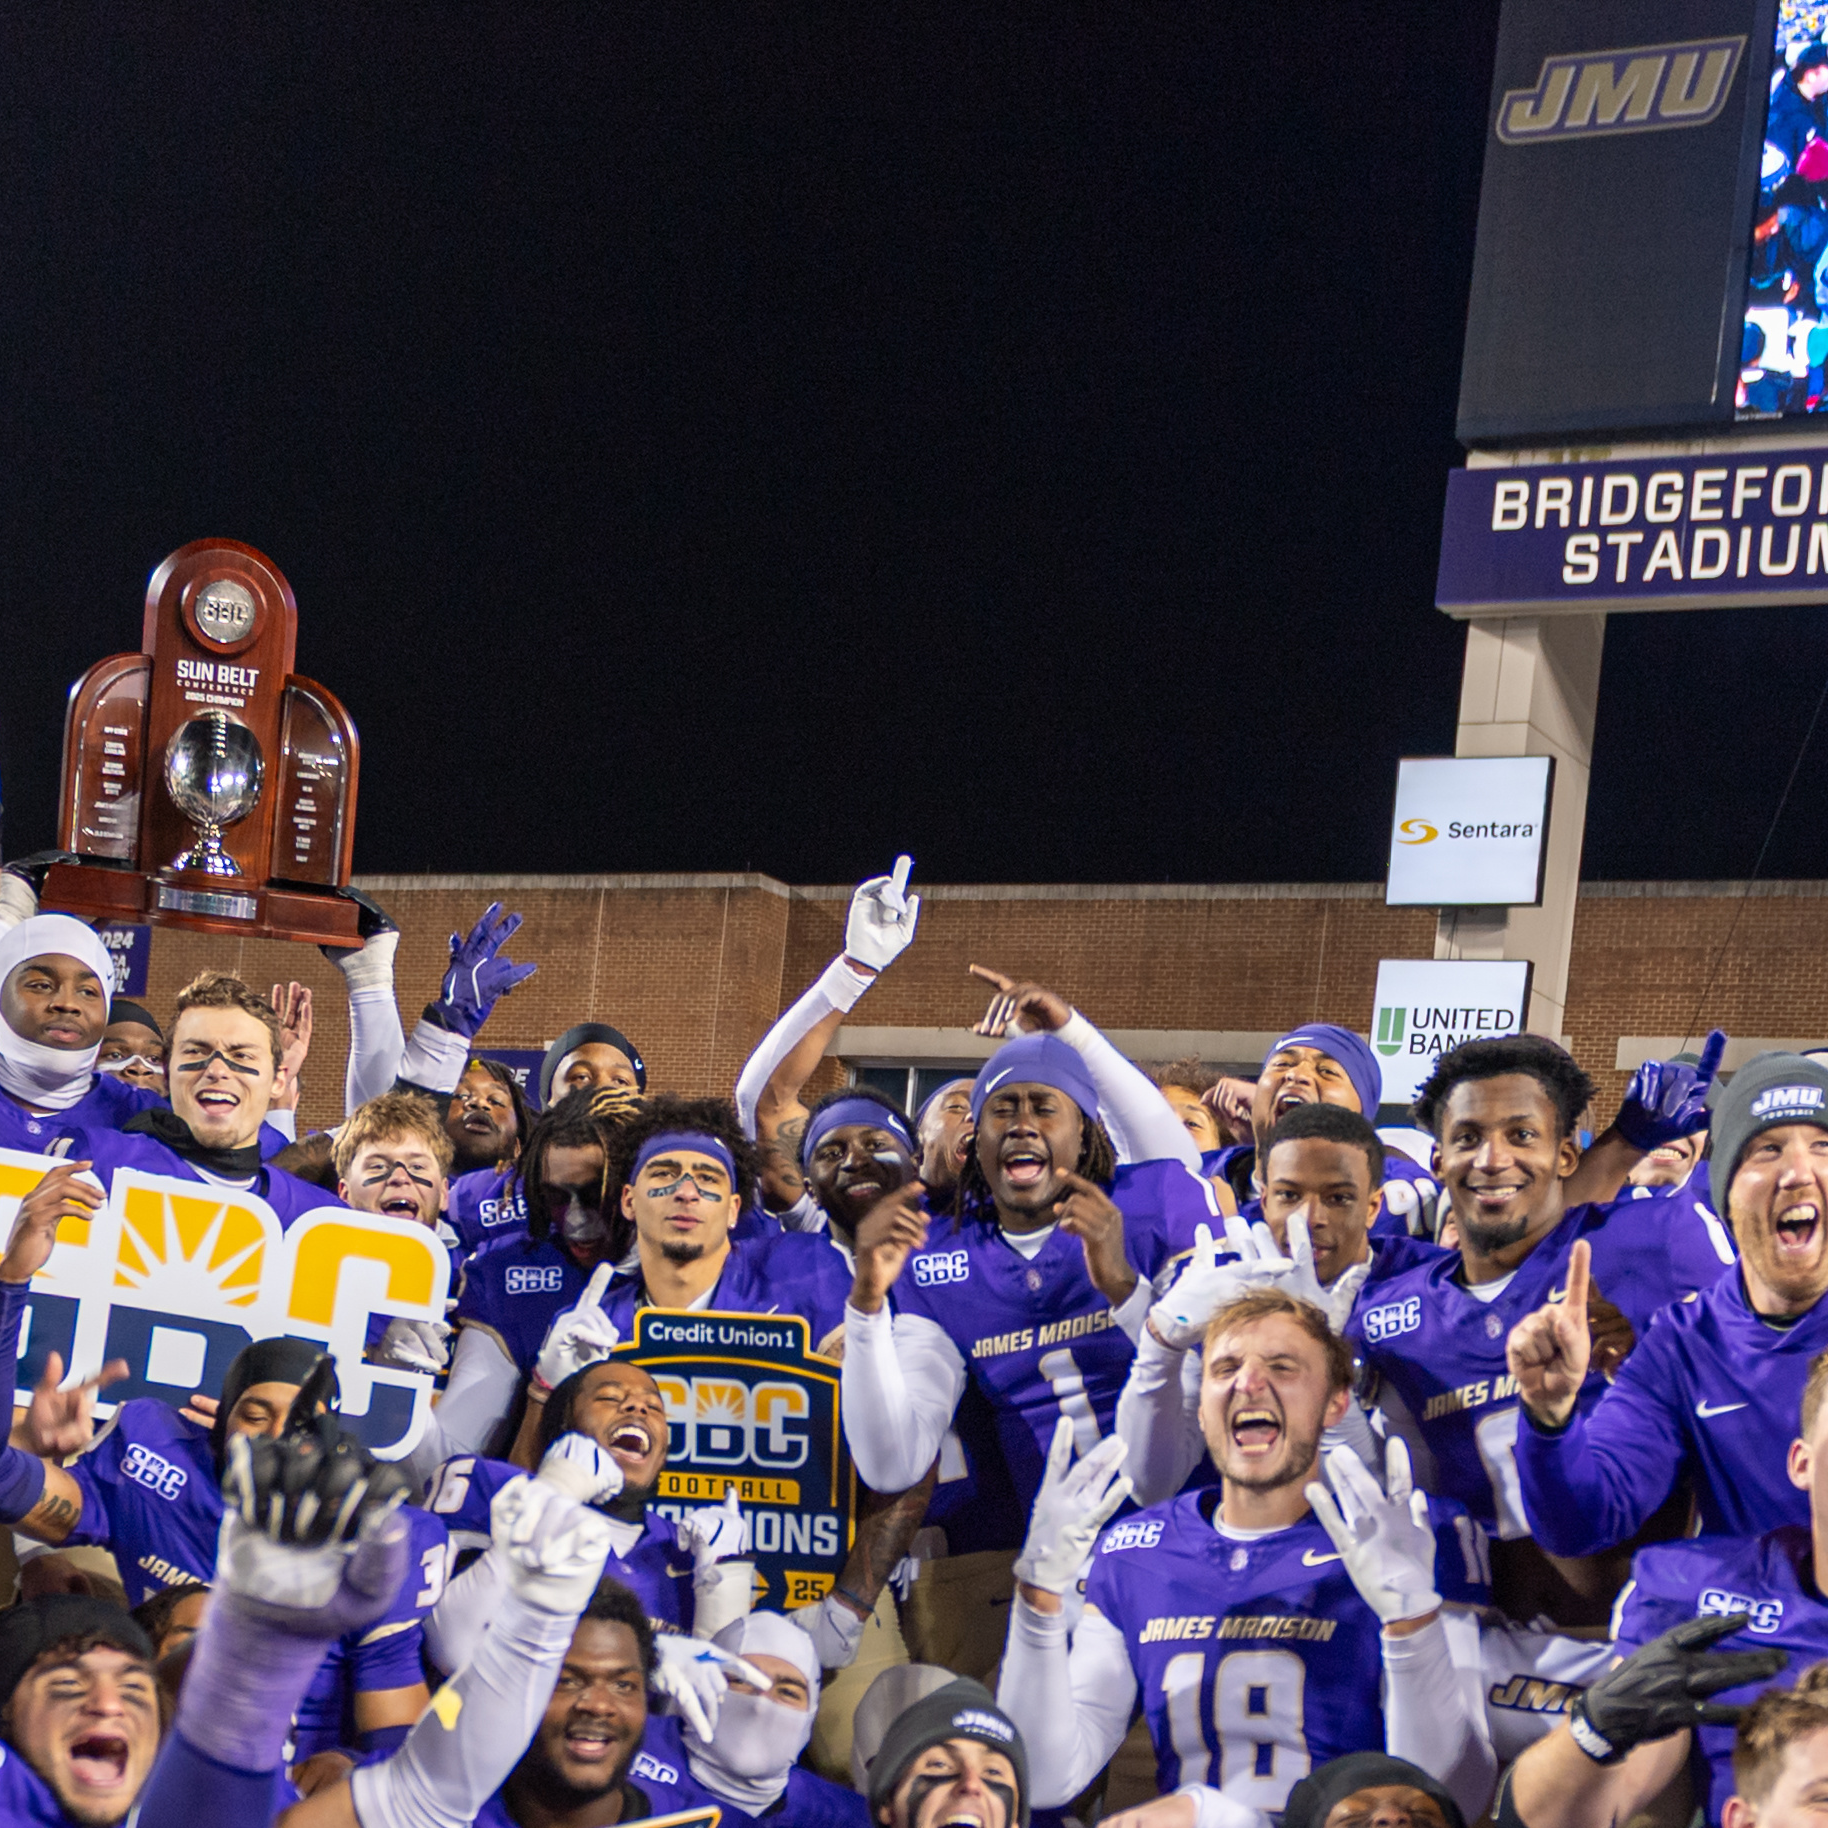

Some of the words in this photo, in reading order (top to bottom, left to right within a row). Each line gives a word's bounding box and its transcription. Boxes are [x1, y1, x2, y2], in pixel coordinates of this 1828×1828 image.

[1500, 40, 1744, 142] JMU
[176, 659, 215, 683] SUN
[217, 664, 260, 688] BELT
[176, 678, 254, 697] CONFERENCE
[1448, 819, 1535, 841] Sentara
[1411, 1007, 1515, 1032] UNITED
[1751, 1086, 1827, 1118] JMU
[505, 1265, 563, 1295] SBC
[913, 1249, 970, 1288] SBC
[647, 1321, 715, 1344] Credit
[718, 1326, 783, 1348] Union
[785, 1330, 796, 1349] 1
[971, 1324, 1034, 1360] JAMES
[1036, 1309, 1118, 1348] MADIS
[1363, 1296, 1422, 1343] SBC
[1422, 1381, 1490, 1422] JAMES
[119, 1441, 190, 1501] SBC
[1101, 1519, 1165, 1554] SBC
[793, 1578, 825, 1602] 25
[1139, 1614, 1215, 1644] JAMES
[1216, 1616, 1337, 1642] MADISON
[1158, 1650, 1313, 1813] 18
